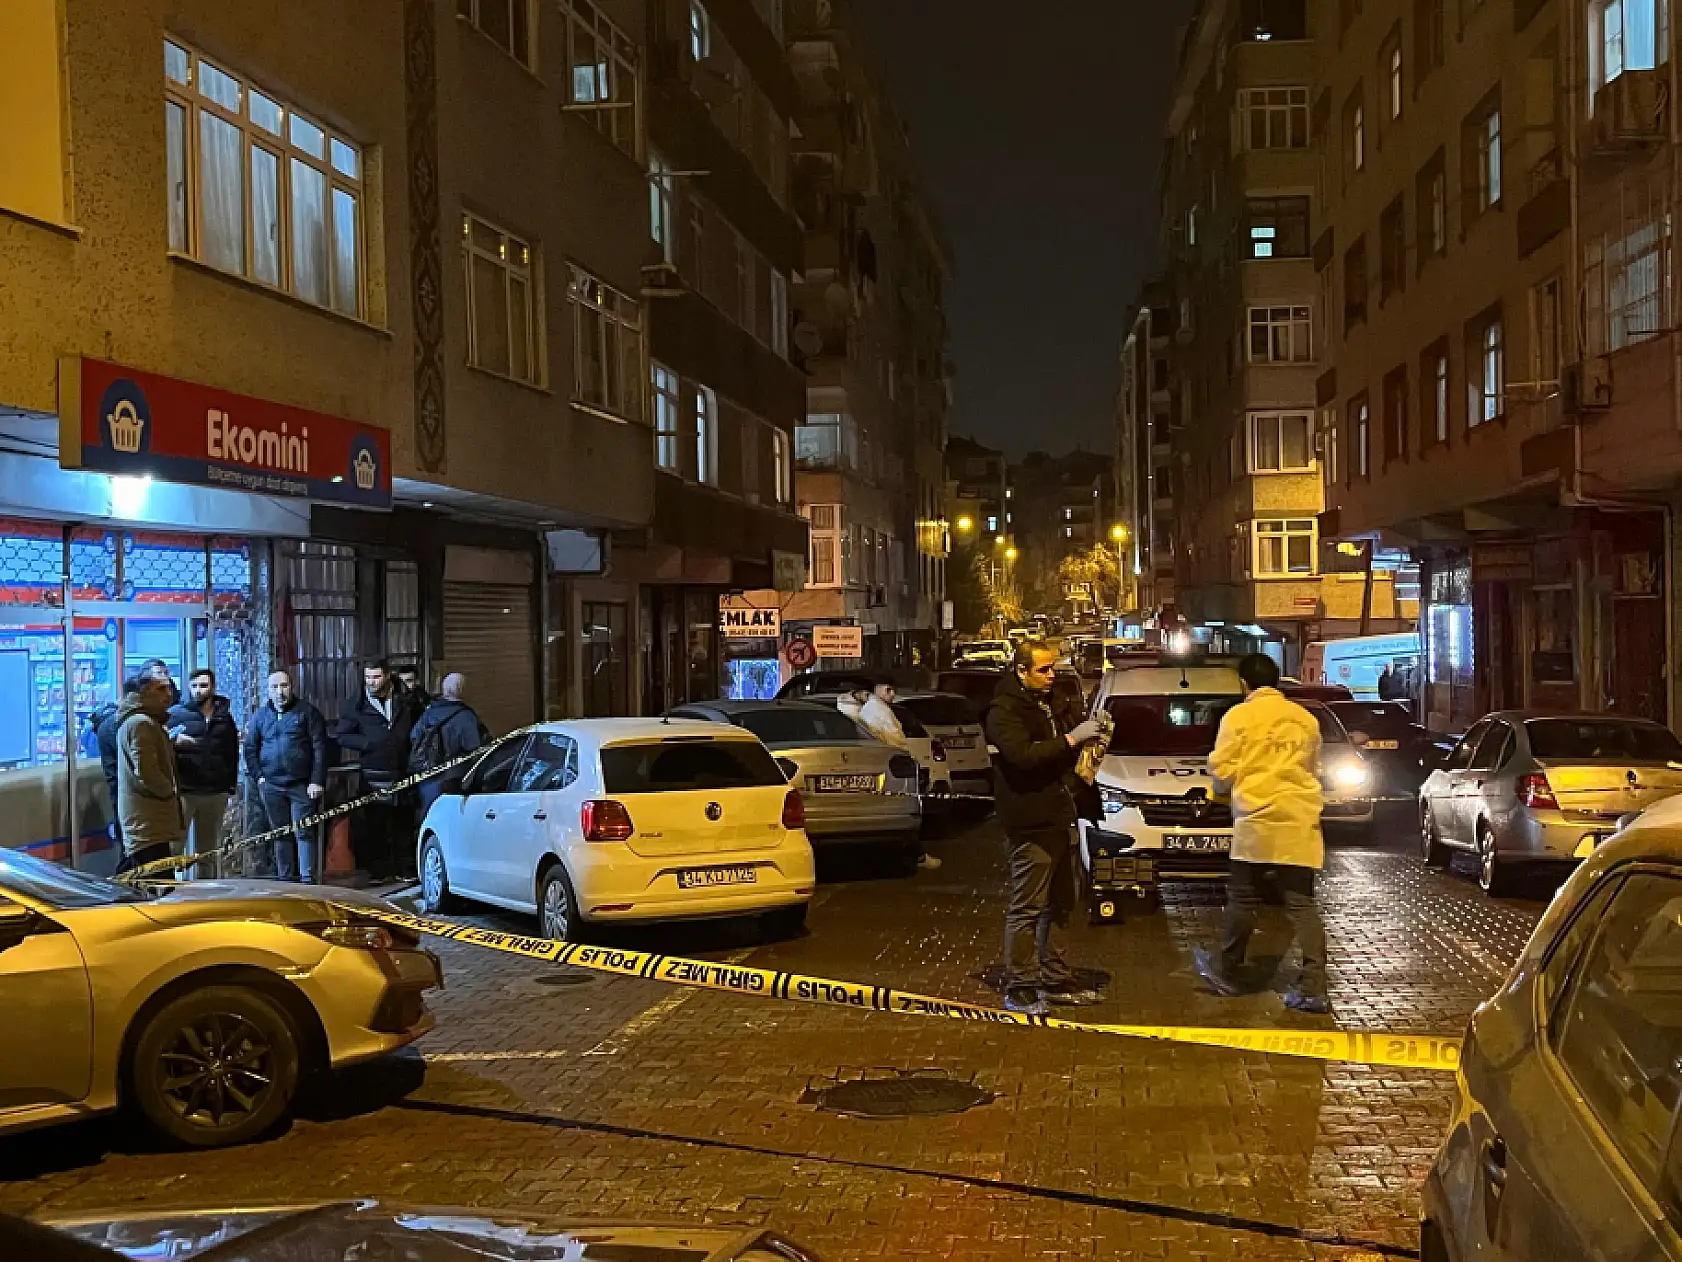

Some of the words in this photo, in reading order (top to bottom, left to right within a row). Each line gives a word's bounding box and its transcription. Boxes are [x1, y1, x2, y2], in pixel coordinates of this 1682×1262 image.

[207, 408, 308, 473] Ekomini
[1147, 768, 1210, 777] POL
[1167, 836, 1182, 849] 34
[1185, 836, 1196, 849] A
[684, 871, 702, 887] 34
